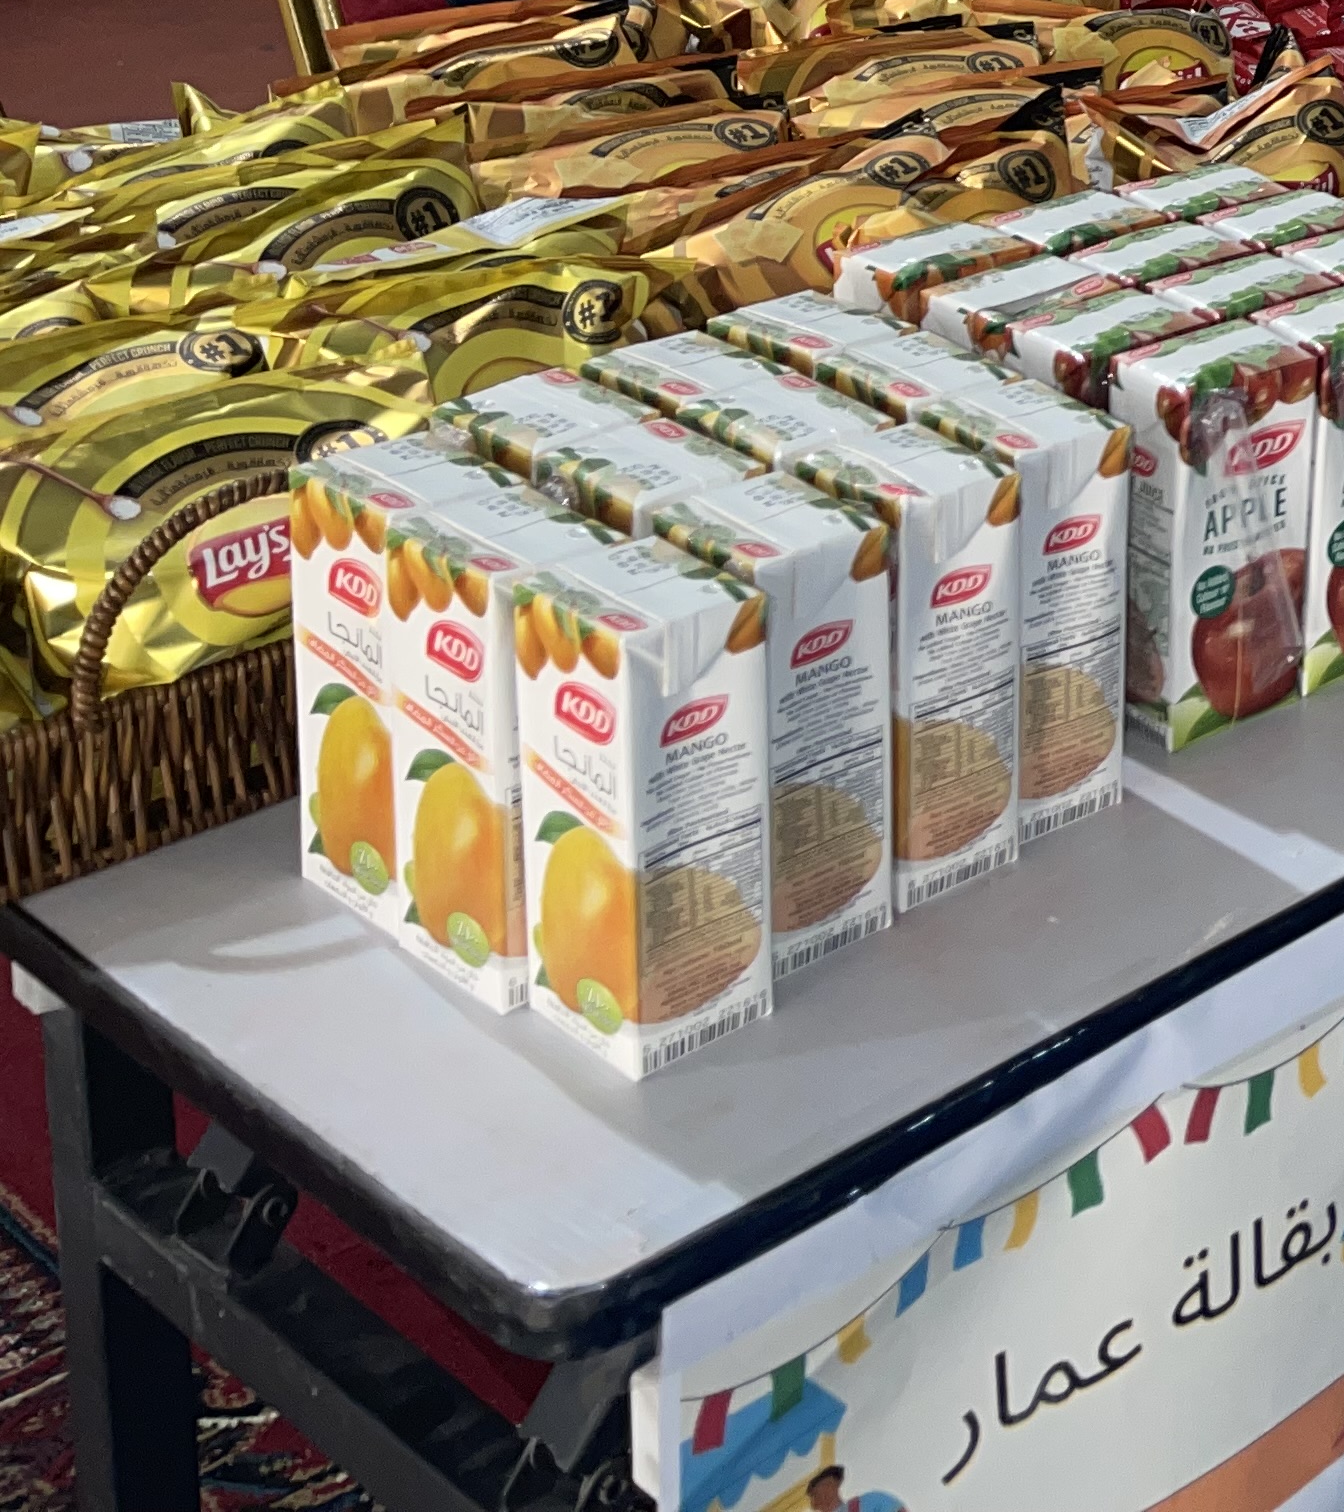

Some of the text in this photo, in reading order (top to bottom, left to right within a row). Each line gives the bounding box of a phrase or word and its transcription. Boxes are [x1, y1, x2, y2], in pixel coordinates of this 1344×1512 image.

[727, 120, 771, 143] #1
[1308, 108, 1344, 137] #1
[1016, 157, 1046, 184] #1
[410, 200, 451, 233] #1
[89, 342, 172, 371] PERFECT CRUNCH
[1203, 487, 1288, 542] APPLE
[1049, 523, 1094, 547] KDD
[202, 524, 290, 589] Lay's
[1046, 549, 1101, 572] MANGO
[335, 567, 378, 606] KDD
[935, 573, 985, 600] KDD
[935, 600, 994, 626] MANGO
[433, 629, 479, 671] KDD
[797, 630, 845, 659] KDD
[795, 655, 853, 686] MANGO
[561, 691, 612, 734] KDD
[667, 705, 718, 737] KDD
[665, 732, 729, 765] MANGO
[940, 1198, 1339, 1485] بقالة عمار
